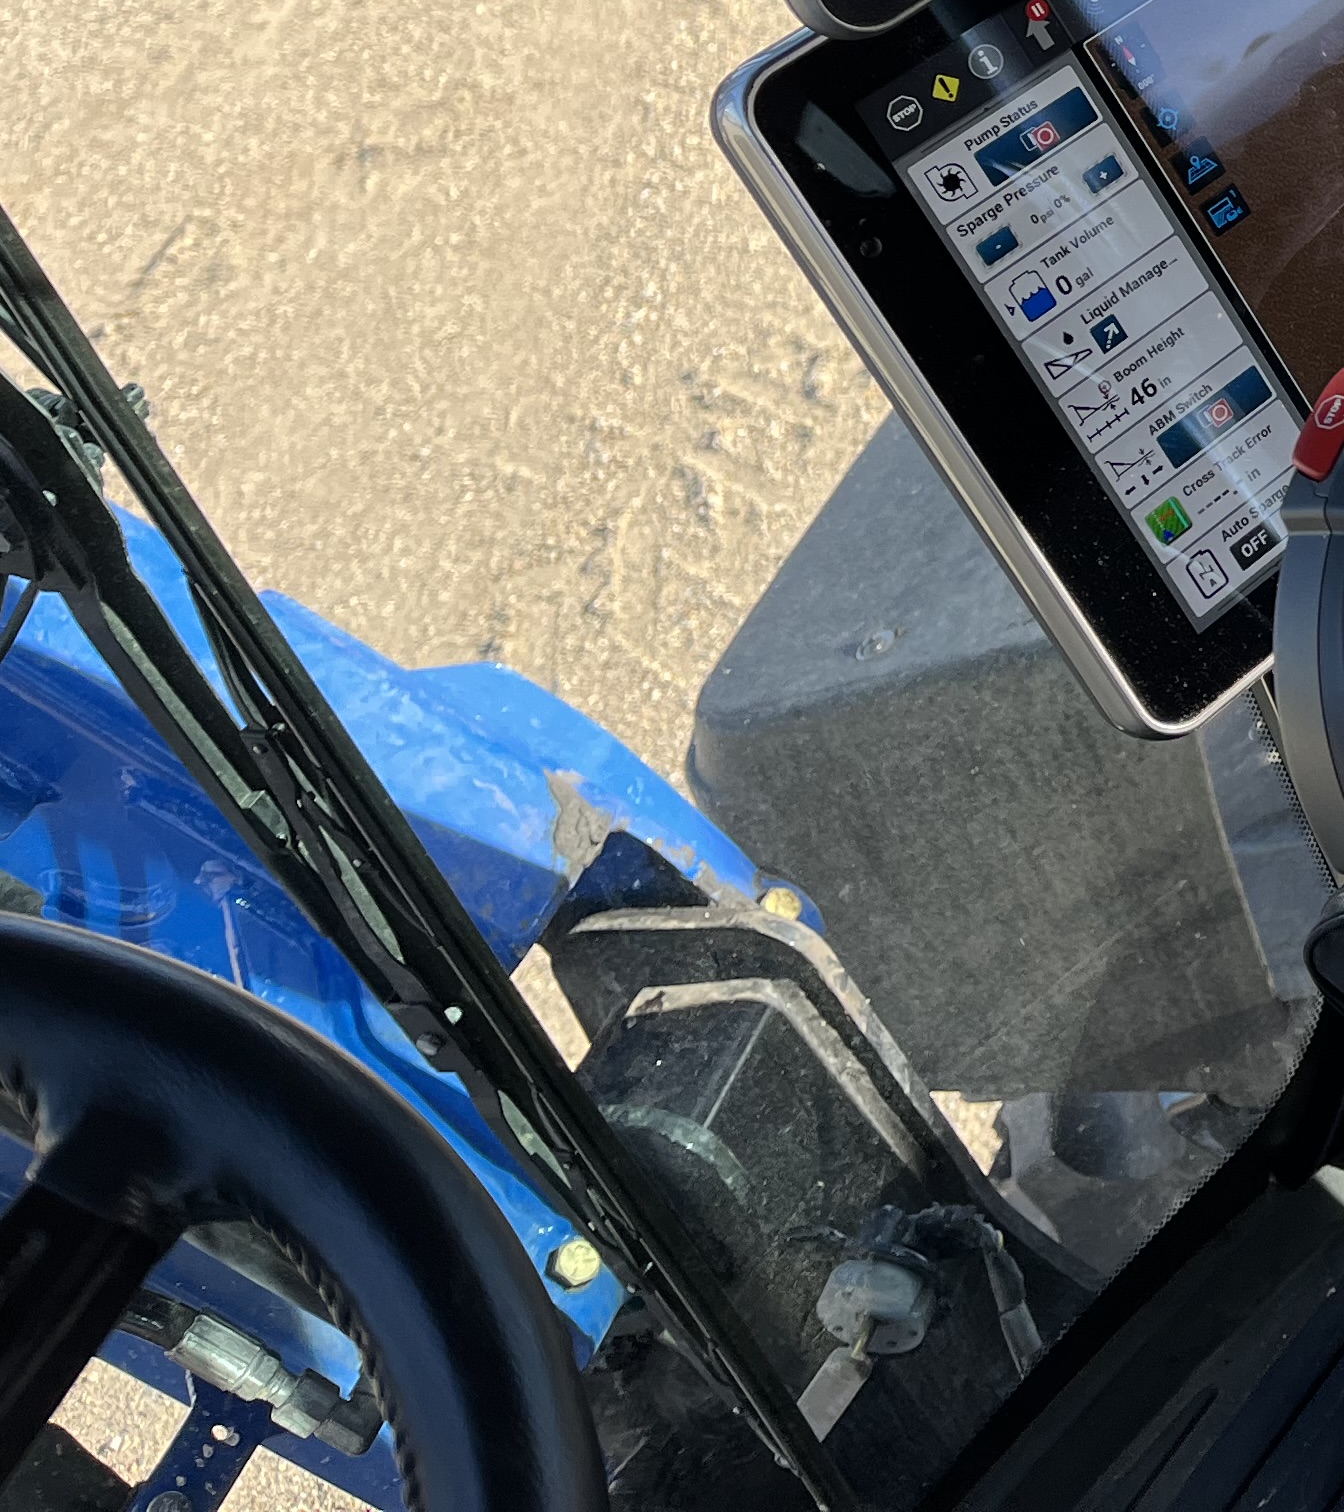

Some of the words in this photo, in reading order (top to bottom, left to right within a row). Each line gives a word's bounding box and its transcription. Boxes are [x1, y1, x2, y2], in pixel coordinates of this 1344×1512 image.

[892, 103, 916, 122] STOP
[963, 124, 1000, 151] Pump
[999, 100, 1037, 128] Status
[956, 203, 1003, 237] Sparge
[1002, 165, 1059, 206] Pressure
[1053, 194, 1070, 208] 0%
[1039, 245, 1071, 268] Tank
[1068, 216, 1114, 248] Volume
[1055, 274, 1072, 295] 0
[1075, 266, 1093, 288] gal
[1079, 291, 1119, 324] Liquid
[1112, 355, 1147, 382] Boom
[1145, 327, 1184, 358] Height
[1131, 377, 1157, 405] 46
[1157, 376, 1171, 388] in
[1148, 409, 1176, 435] ABM
[1175, 384, 1212, 414] Switch
[1323, 398, 1341, 424] STOP
[1182, 469, 1215, 496] Cross
[1212, 445, 1246, 471] Track
[1244, 424, 1271, 449] Error
[1245, 468, 1260, 481] in
[1221, 516, 1249, 542] Auto
[1241, 529, 1267, 557] OFF
